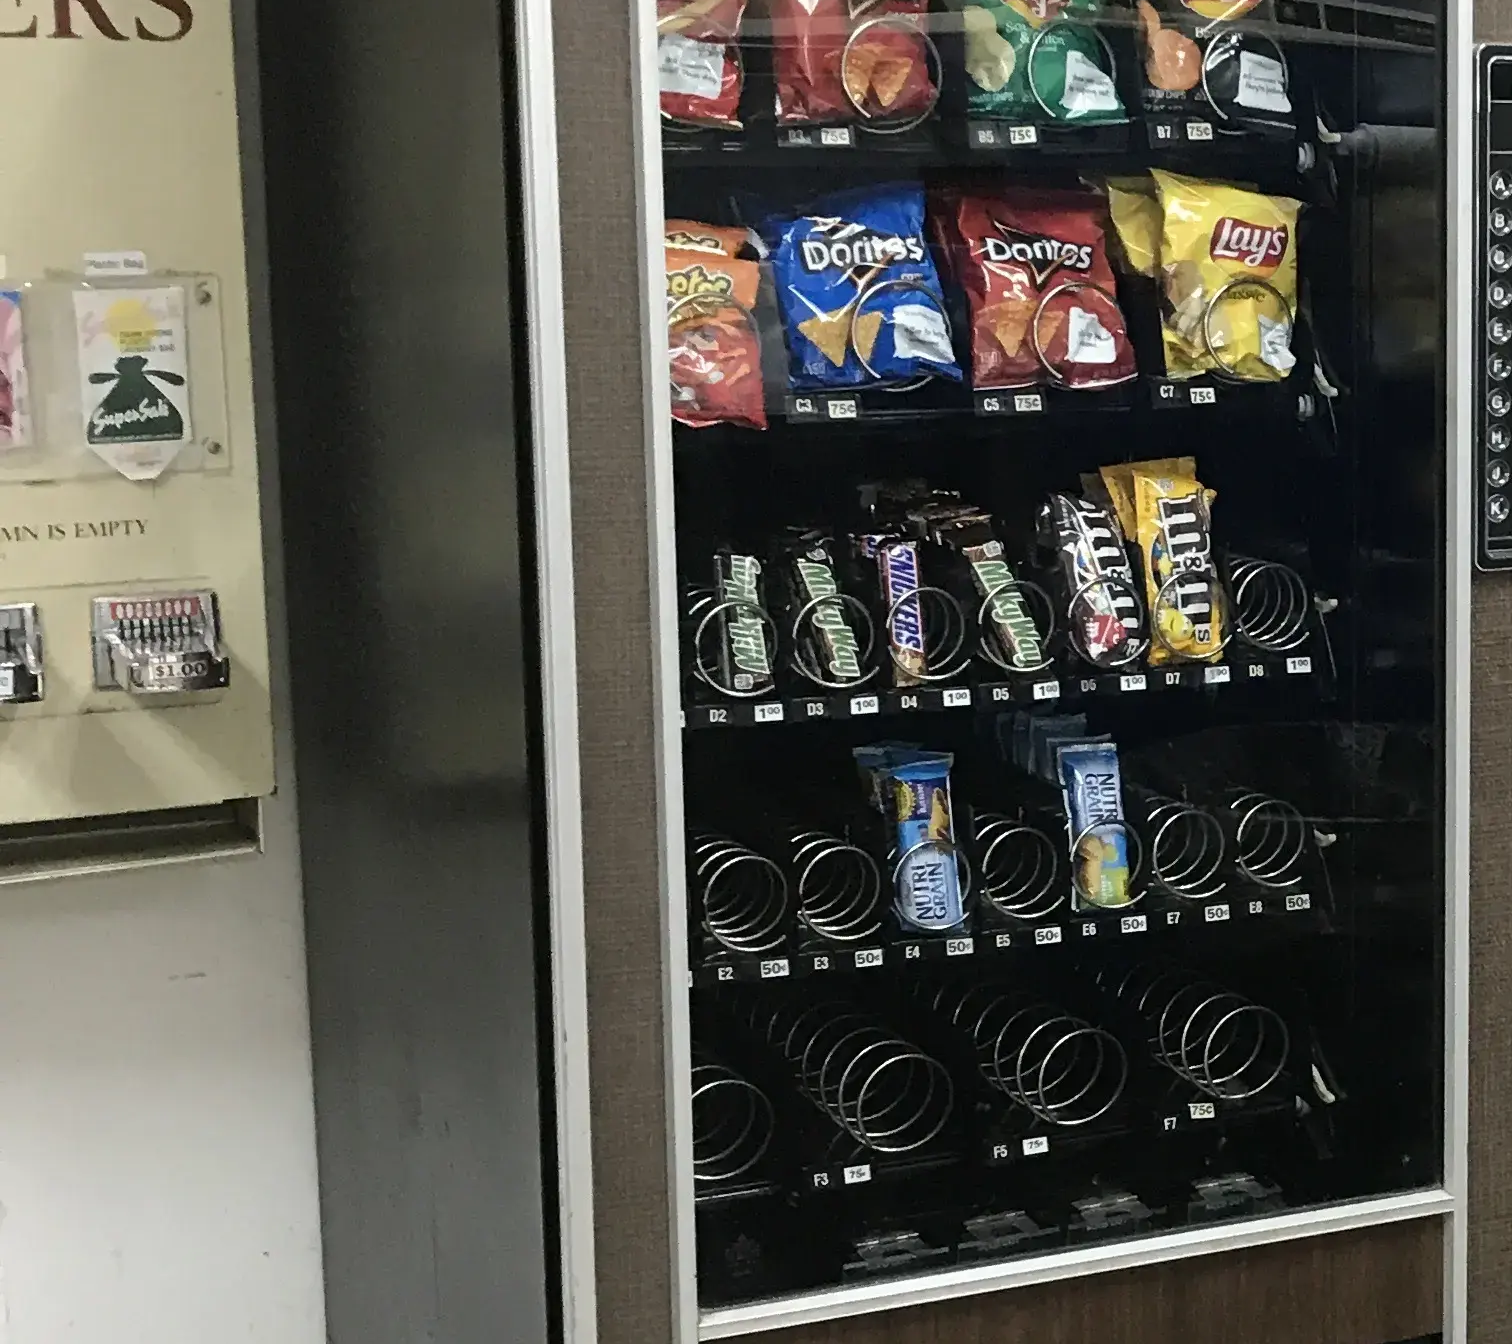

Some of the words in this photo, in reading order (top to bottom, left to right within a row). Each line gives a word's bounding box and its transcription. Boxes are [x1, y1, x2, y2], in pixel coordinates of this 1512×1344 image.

[802, 236, 923, 271] Doritos
[985, 237, 1092, 269] Doritos
[1160, 385, 1174, 398] C7
[47, 524, 66, 541] IS
[74, 519, 149, 538] EMPTY
[889, 544, 923, 652] SNICKERS
[156, 663, 207, 678] $1.00
[1249, 664, 1264, 677] D8
[1166, 672, 1181, 685] D7
[992, 688, 1009, 701] D5
[901, 695, 918, 708] D4
[709, 709, 727, 723] D2
[807, 702, 824, 717] D3
[911, 865, 935, 920] NUTRI
[927, 862, 947, 920] GRAIN
[1249, 901, 1262, 914] E8
[1167, 913, 1180, 925] E7
[1082, 923, 1096, 936] E6
[996, 935, 1010, 947] E5
[905, 945, 920, 958] E4
[814, 957, 829, 970] E3
[718, 968, 733, 980] E2
[1164, 1117, 1176, 1130] F7
[993, 1145, 1008, 1159] F5
[813, 1173, 828, 1187] F3
